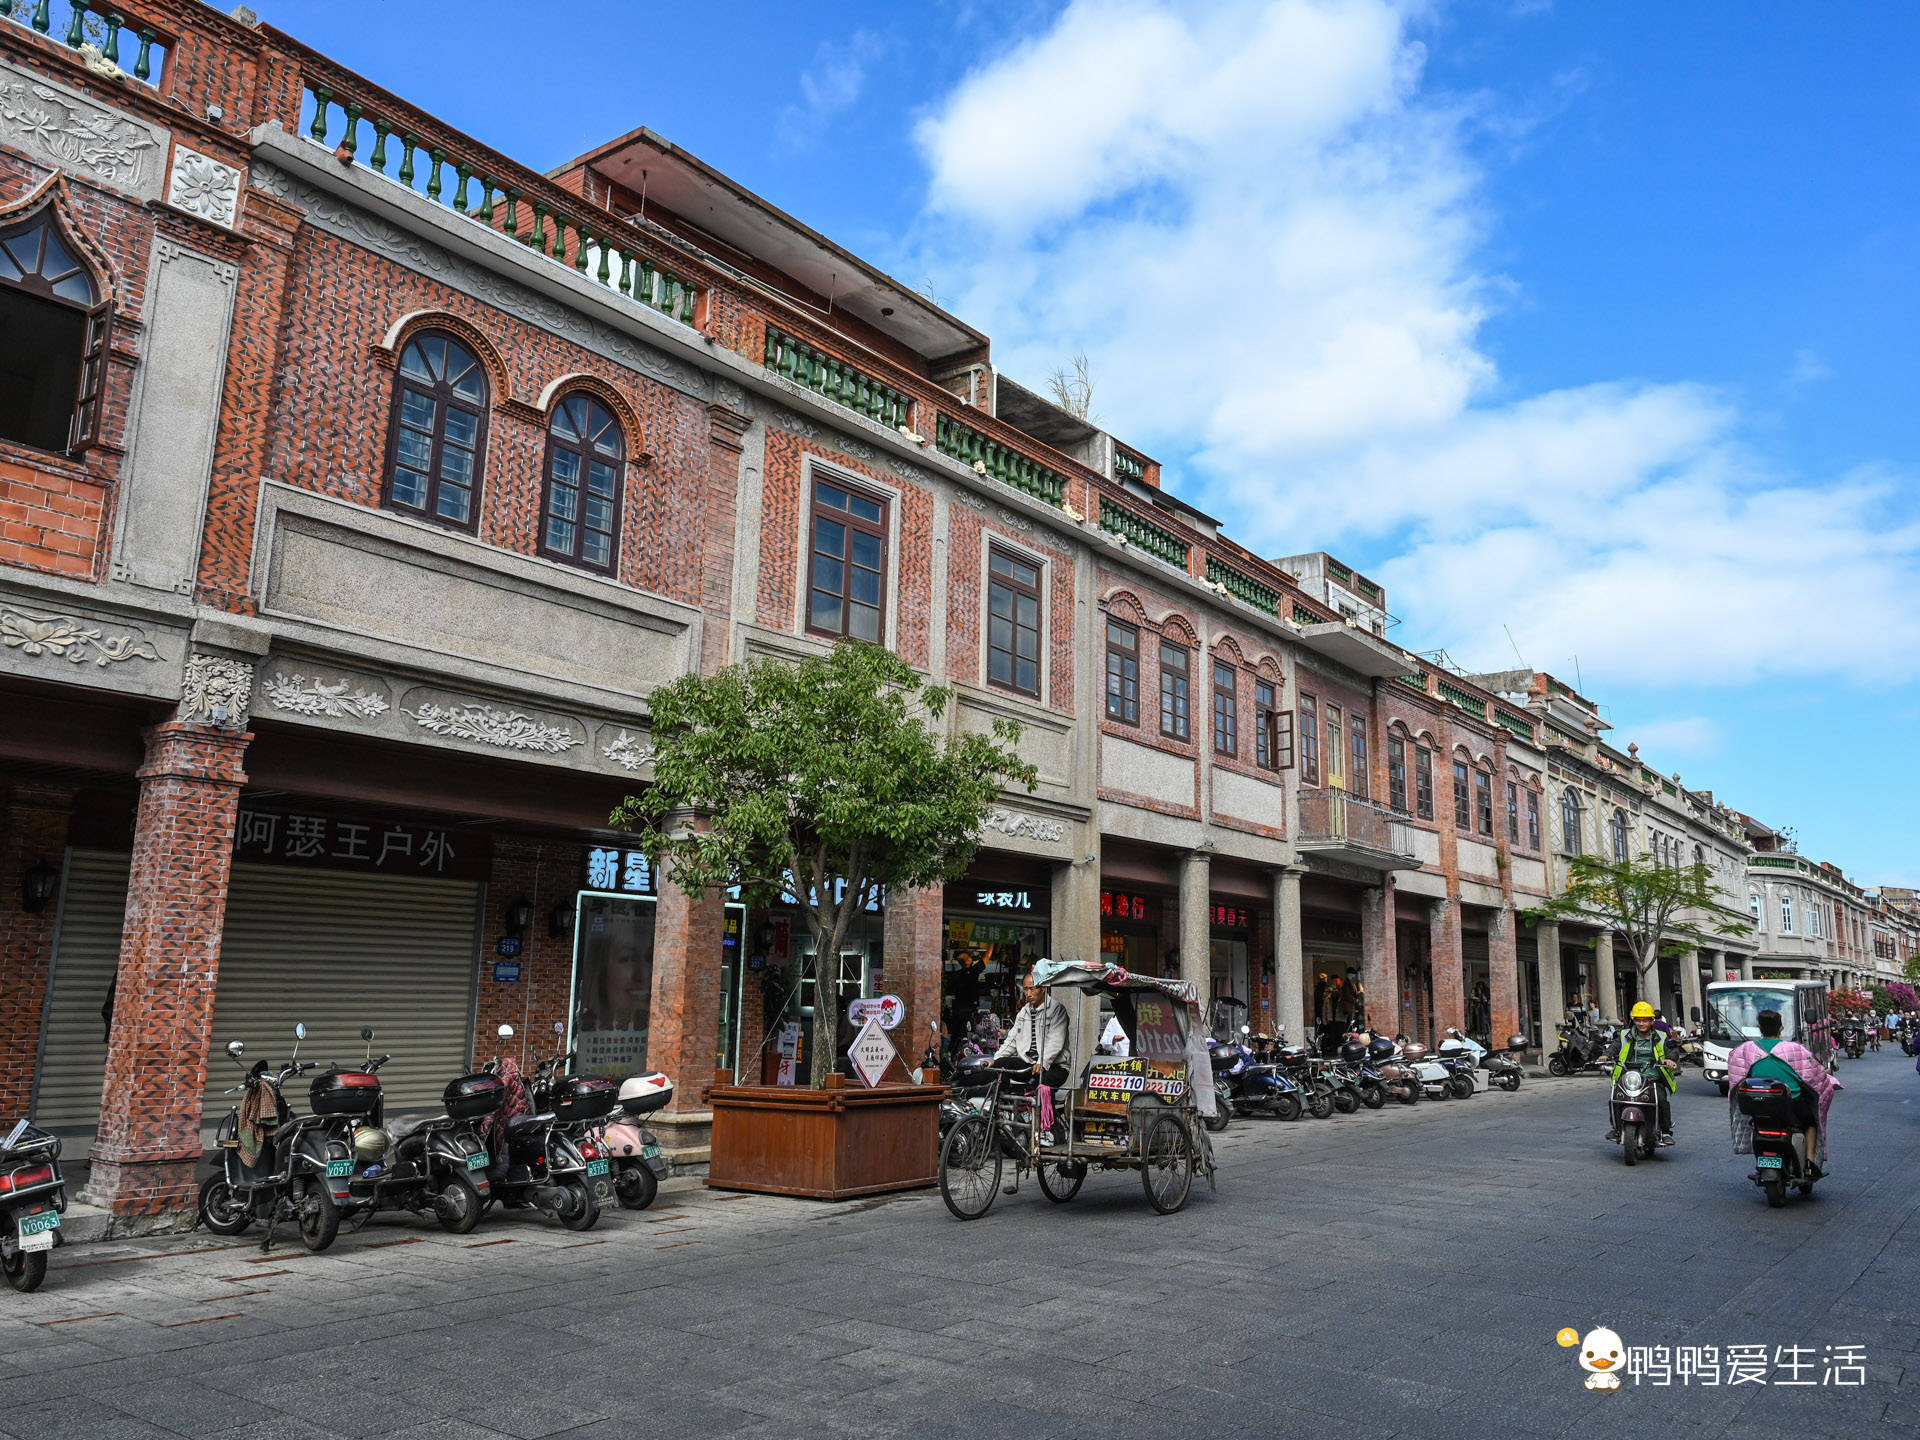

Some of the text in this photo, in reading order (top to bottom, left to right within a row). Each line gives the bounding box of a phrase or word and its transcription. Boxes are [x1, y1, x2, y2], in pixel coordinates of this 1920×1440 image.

[236, 809, 455, 871] 阿瑟王户外
[1090, 1076, 1142, 1089] 22222110
[23, 1218, 58, 1234] V0063
